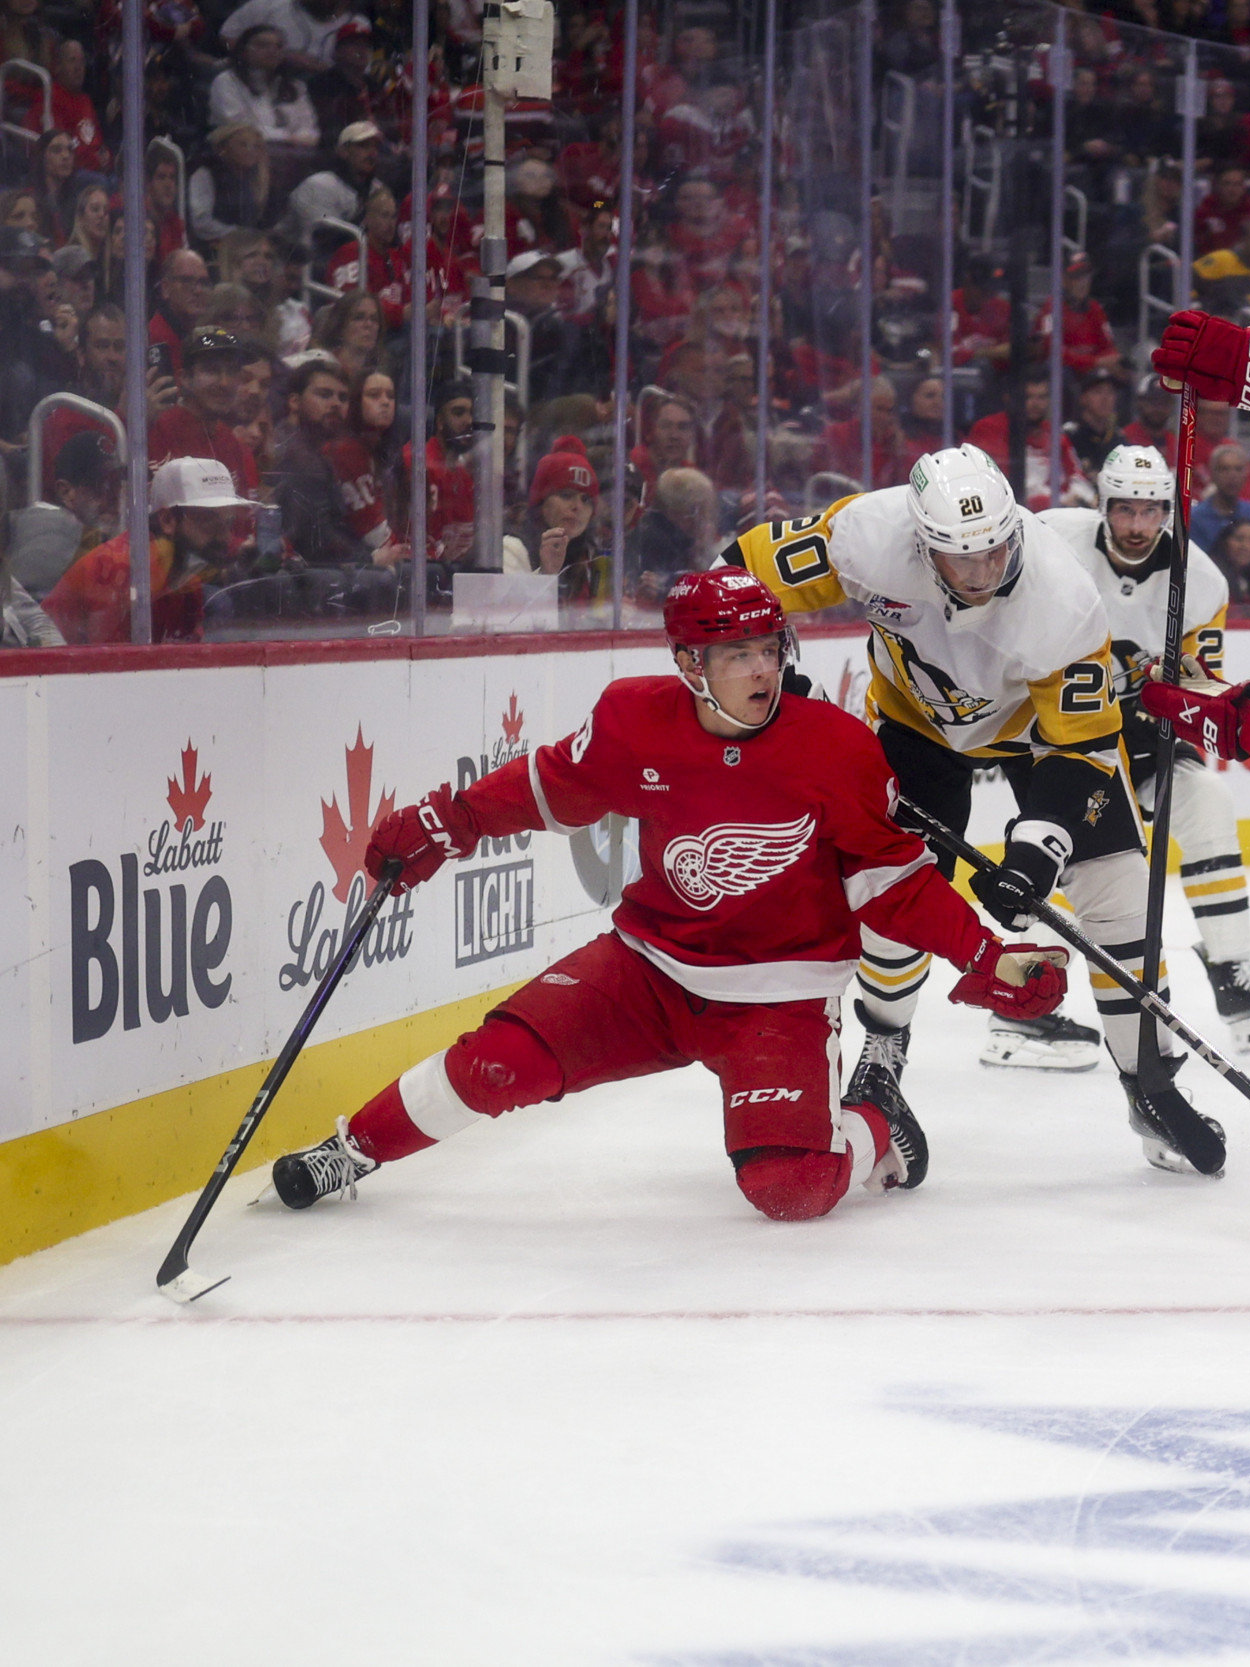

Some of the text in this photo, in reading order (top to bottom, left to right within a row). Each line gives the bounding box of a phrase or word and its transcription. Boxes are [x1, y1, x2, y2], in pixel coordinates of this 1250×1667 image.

[958, 495, 985, 517] 20
[961, 526, 993, 539] CCM
[739, 607, 772, 622] CCM
[639, 784, 670, 792] PRIORITY
[143, 817, 224, 877] Labatt
[998, 881, 1025, 897] CCM
[457, 866, 532, 963] LIGHT
[279, 870, 415, 992] Labatt
[69, 852, 233, 1045] Blue
[729, 1087, 803, 1109] CCM
